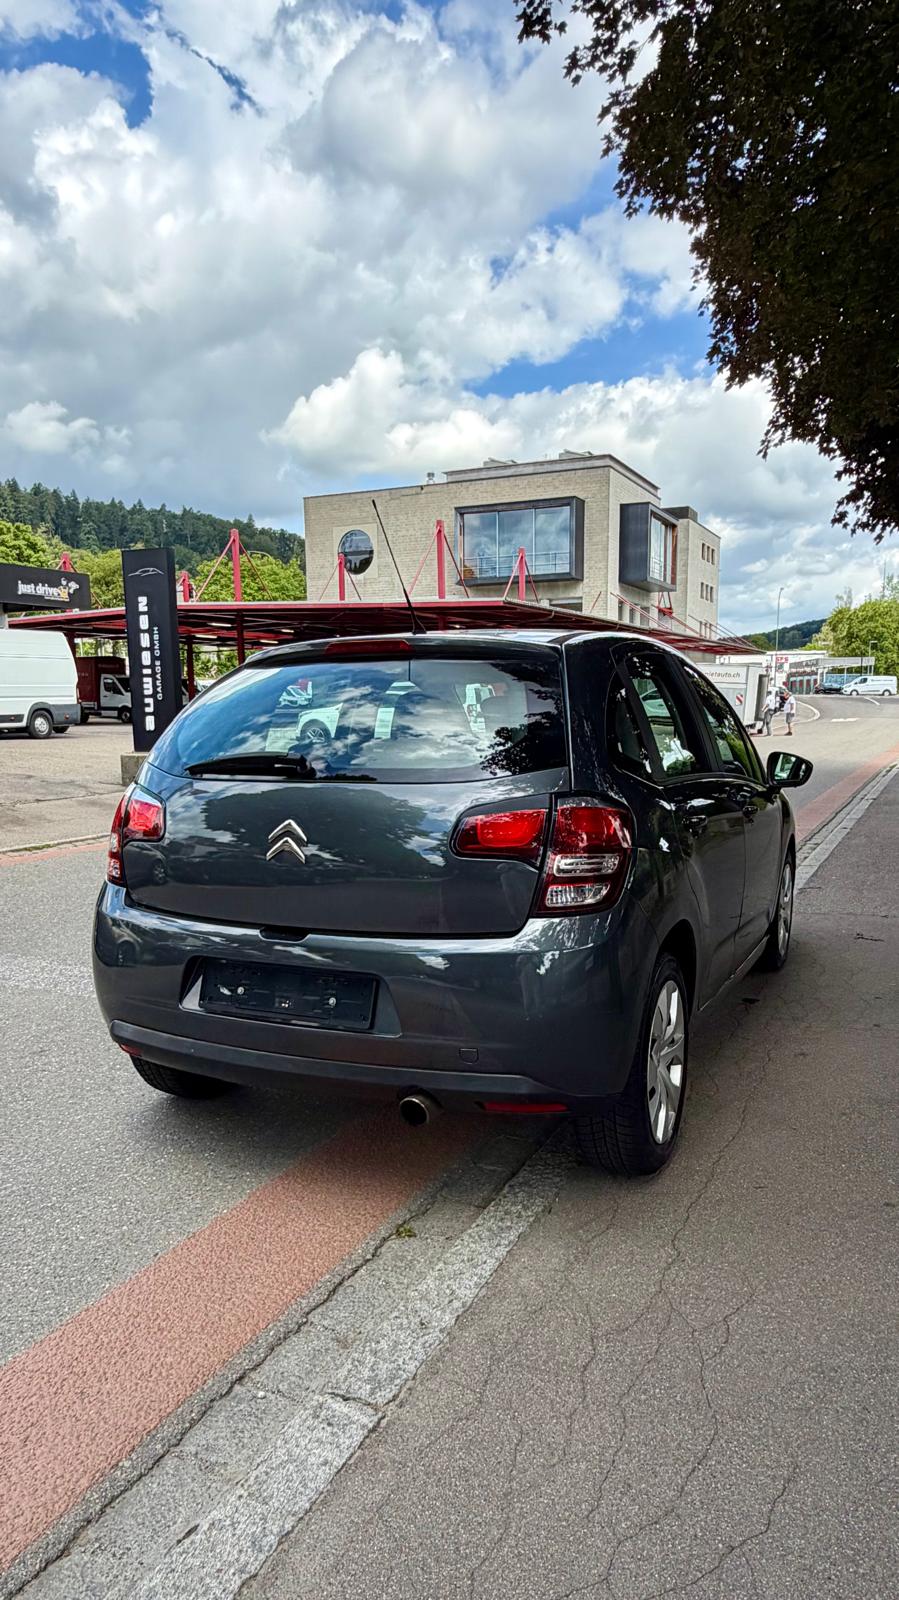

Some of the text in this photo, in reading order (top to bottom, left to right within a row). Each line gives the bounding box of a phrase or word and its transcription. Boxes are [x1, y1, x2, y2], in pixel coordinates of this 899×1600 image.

[17, 581, 58, 596] just drive
[153, 626, 163, 701] GARAGE GMBH
